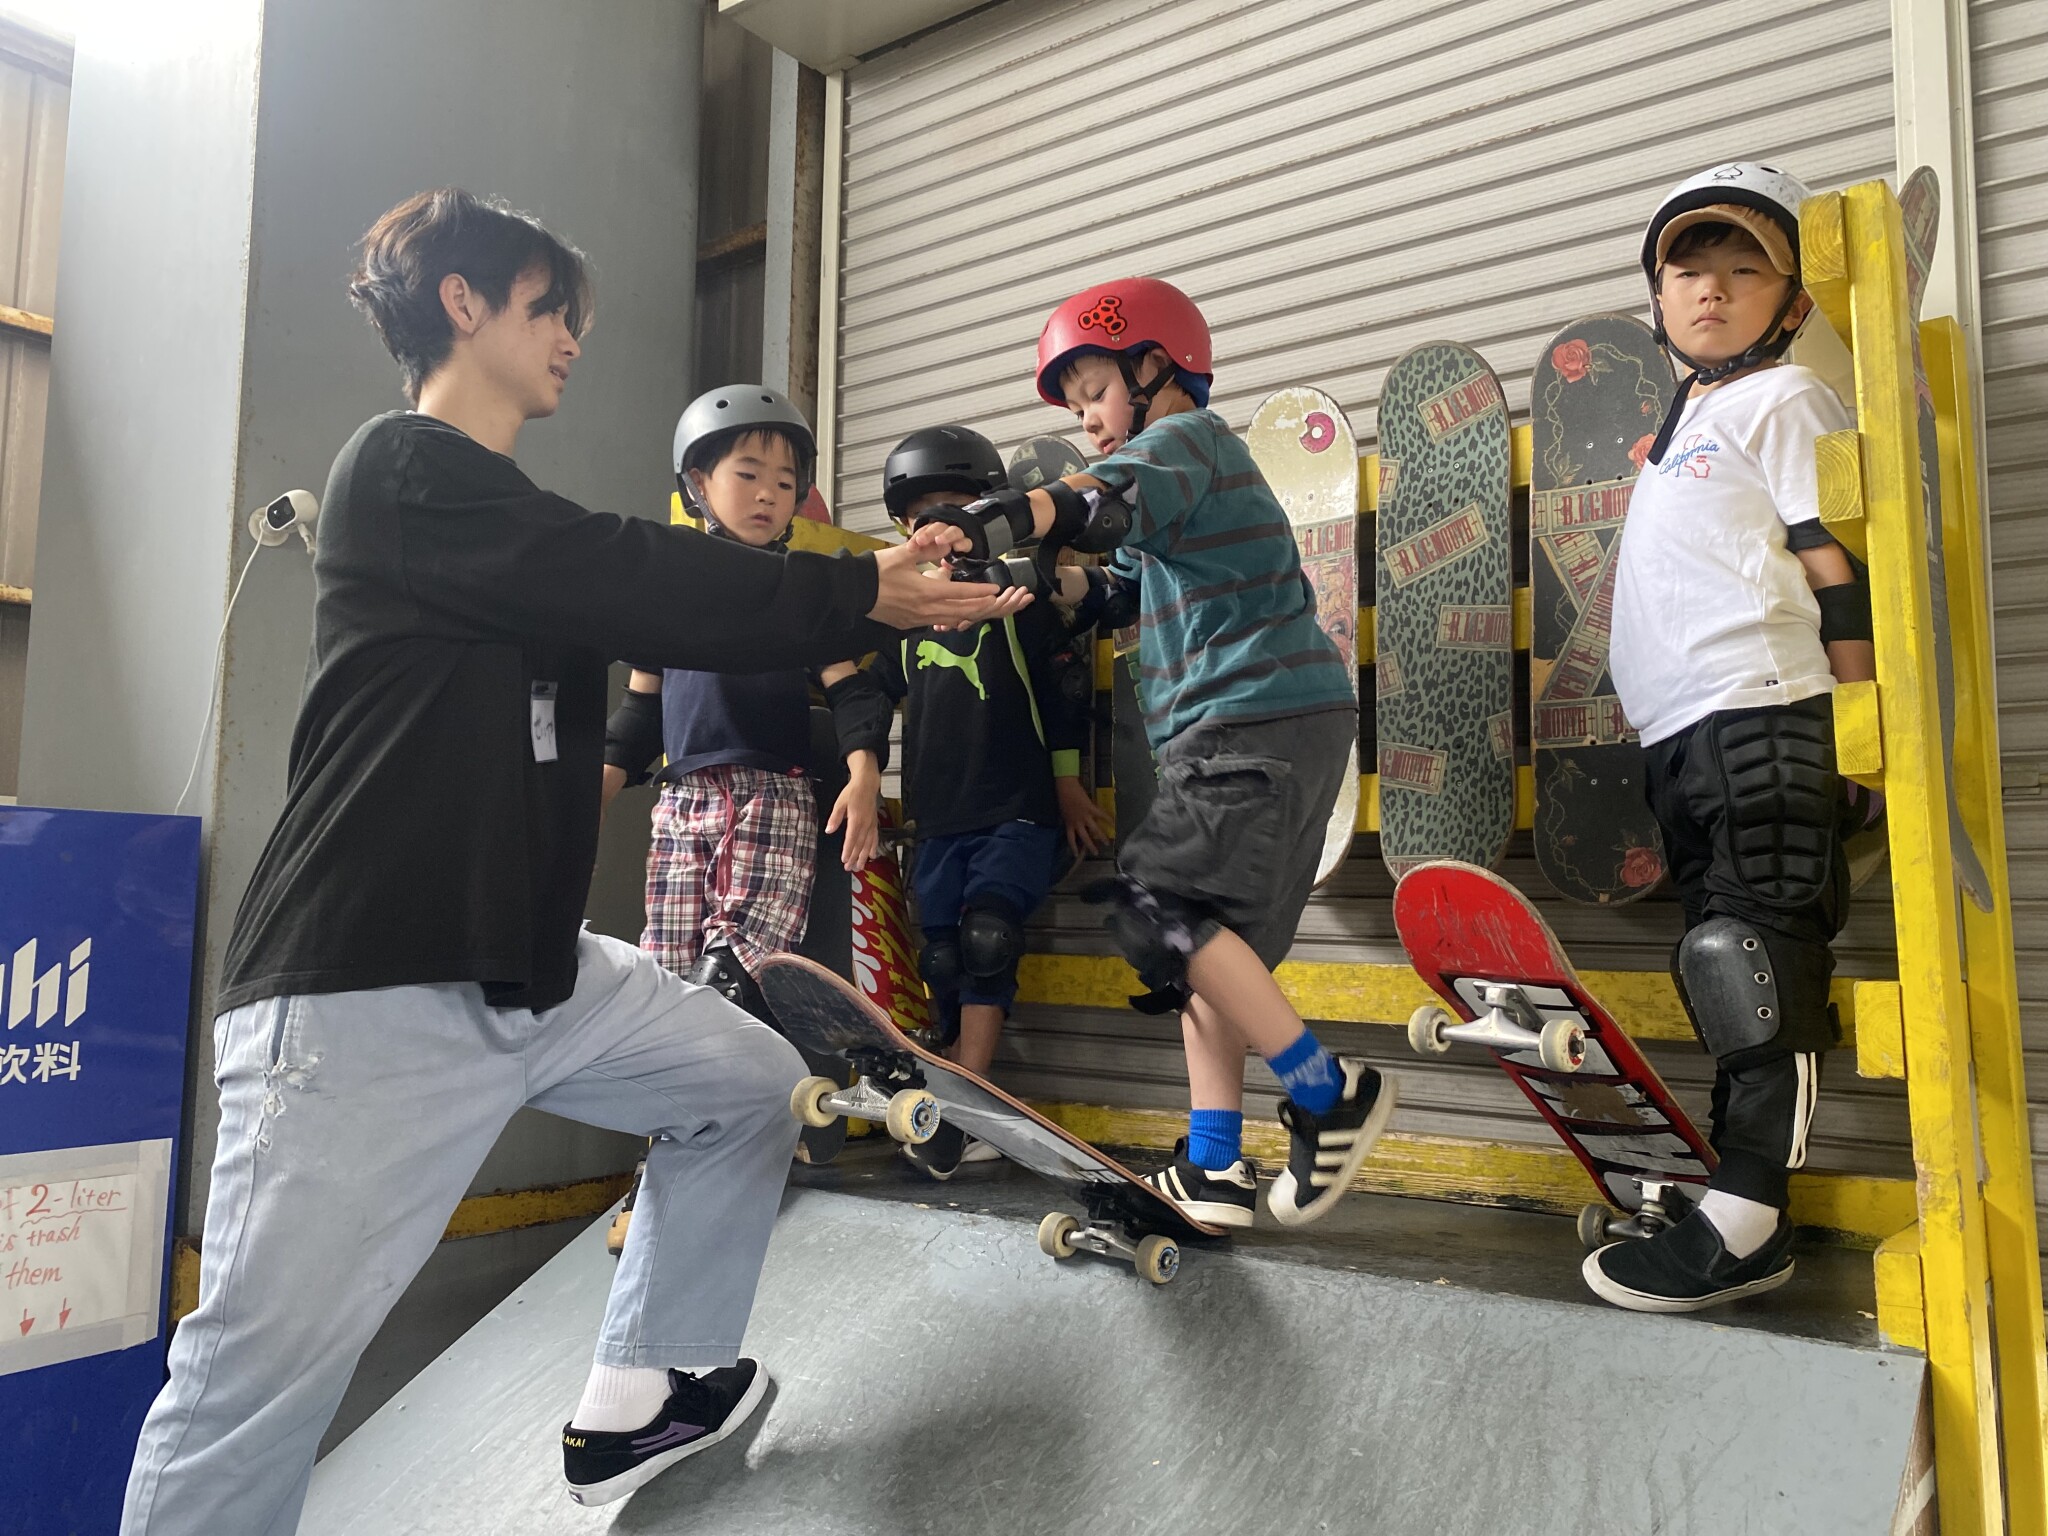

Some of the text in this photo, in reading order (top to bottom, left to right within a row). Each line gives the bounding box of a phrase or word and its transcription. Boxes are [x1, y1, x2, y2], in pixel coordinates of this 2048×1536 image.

[0, 937, 92, 1030] hi
[26, 1215, 82, 1247] trash
[5, 1257, 64, 1290] them
